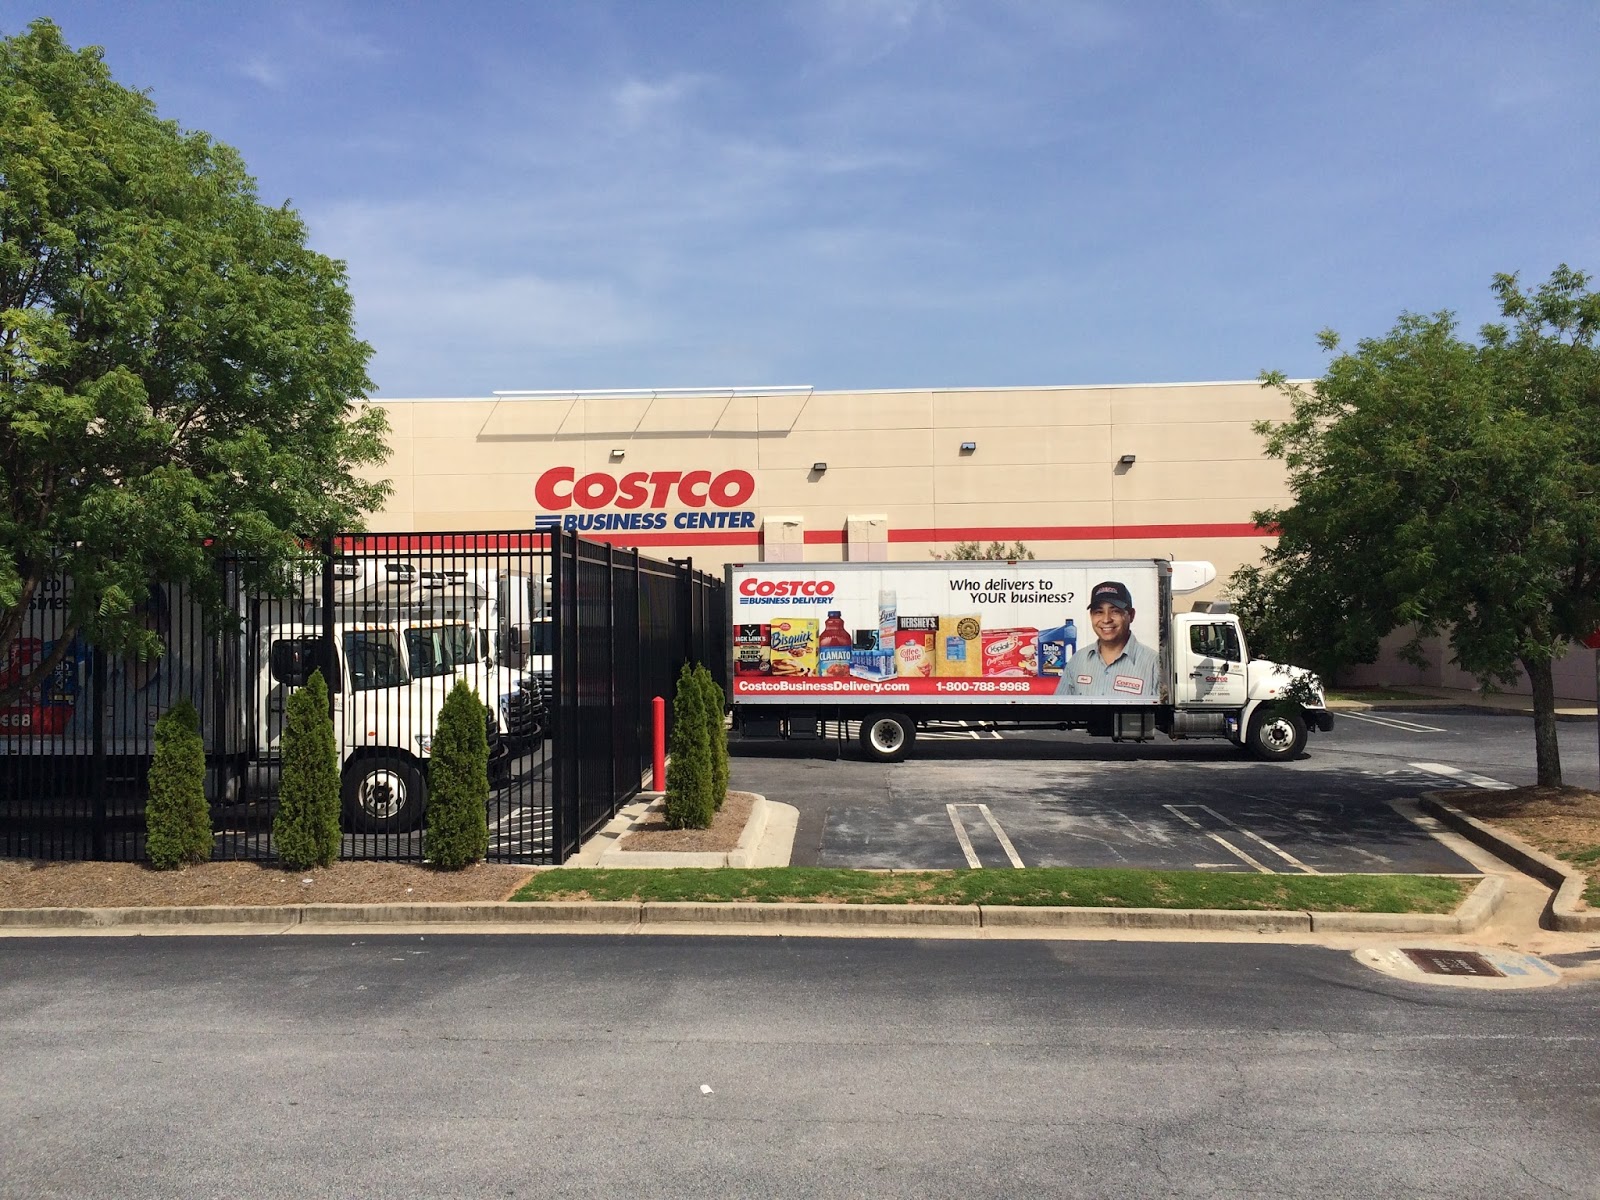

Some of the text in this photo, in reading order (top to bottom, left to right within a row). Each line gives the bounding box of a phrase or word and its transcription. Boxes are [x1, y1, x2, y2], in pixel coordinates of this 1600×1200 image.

[535, 466, 755, 510] COSTCO
[563, 512, 755, 530] BUSINESS CENTER
[739, 578, 835, 596] COSTCO
[950, 579, 1053, 591] Who delivers to
[749, 597, 790, 605] BUSINESS
[970, 592, 1074, 603] YOUR business?
[771, 631, 813, 649] Bisquick
[820, 651, 850, 661] CLAMATO
[739, 681, 1030, 693] CostcoBusinessDelivery.com 1-800-788-9968
[1116, 680, 1140, 688] COSTCO
